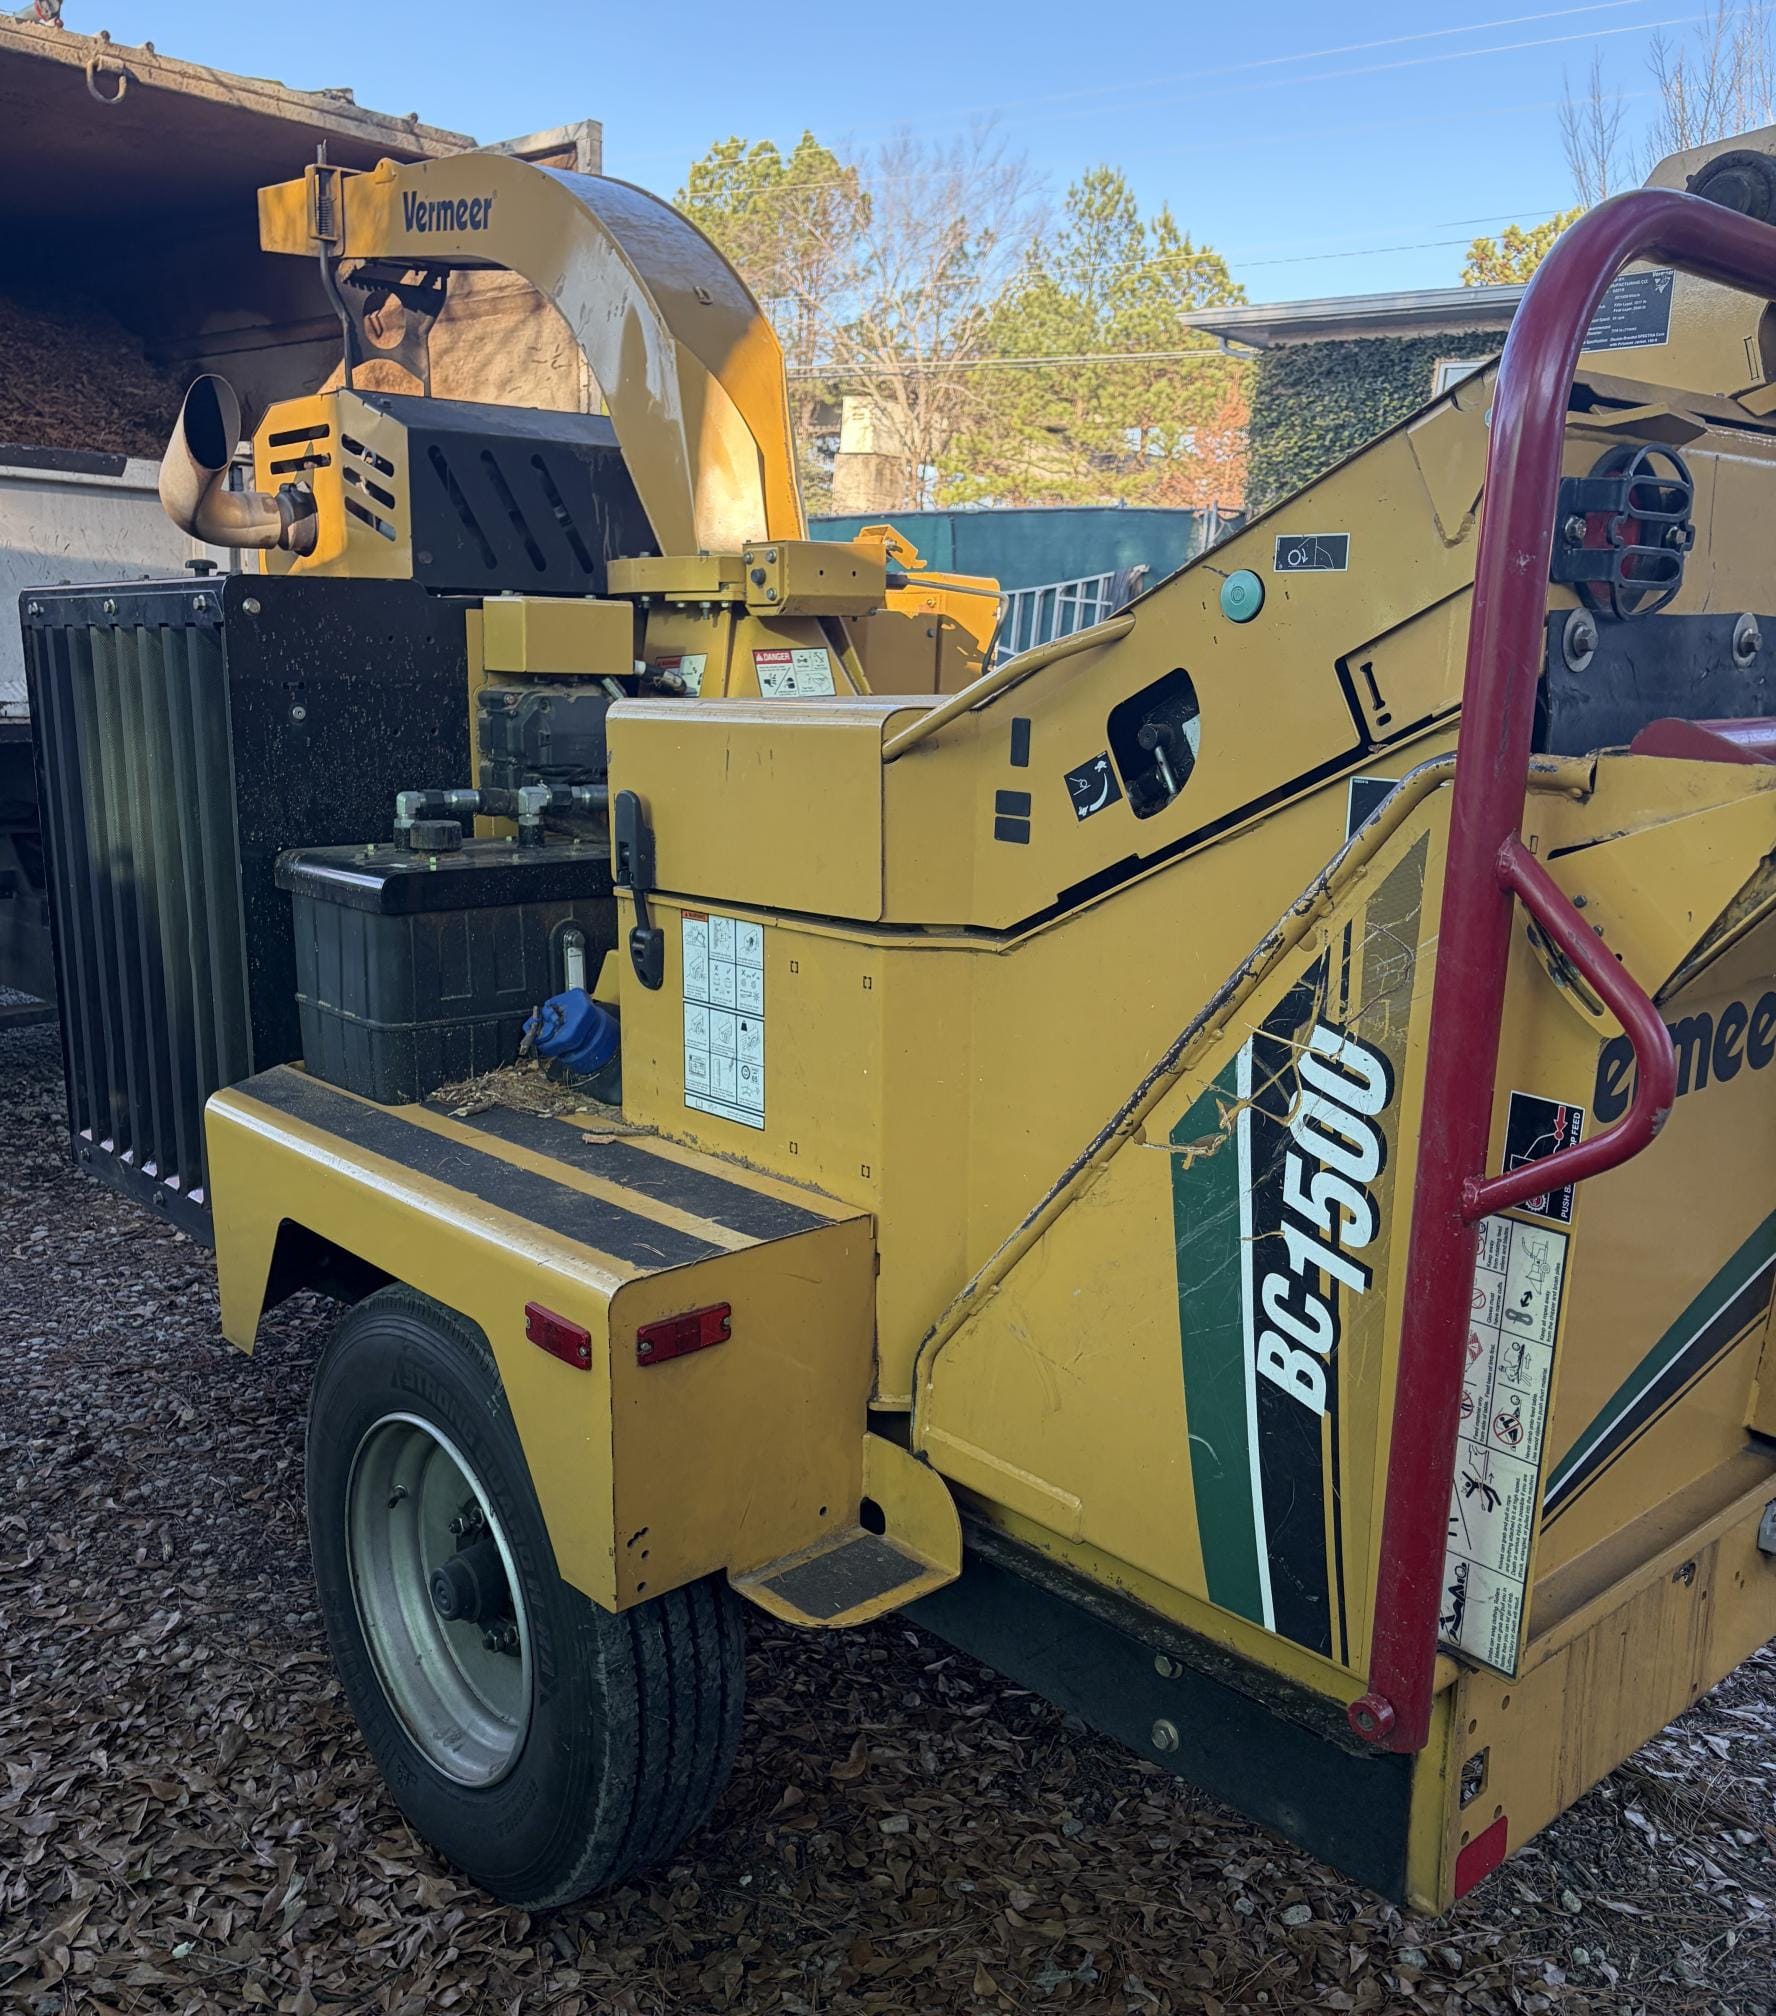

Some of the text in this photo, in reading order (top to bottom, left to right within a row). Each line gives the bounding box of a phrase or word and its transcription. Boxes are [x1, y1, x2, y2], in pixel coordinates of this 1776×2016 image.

[402, 191, 492, 233] Vermeer
[763, 652, 790, 661] DANGER
[1593, 991, 1776, 1124] emee
[1571, 1112, 1580, 1135] FEED
[1257, 1024, 1389, 1417] BC1500
[1561, 1195, 1570, 1218] PUSH
